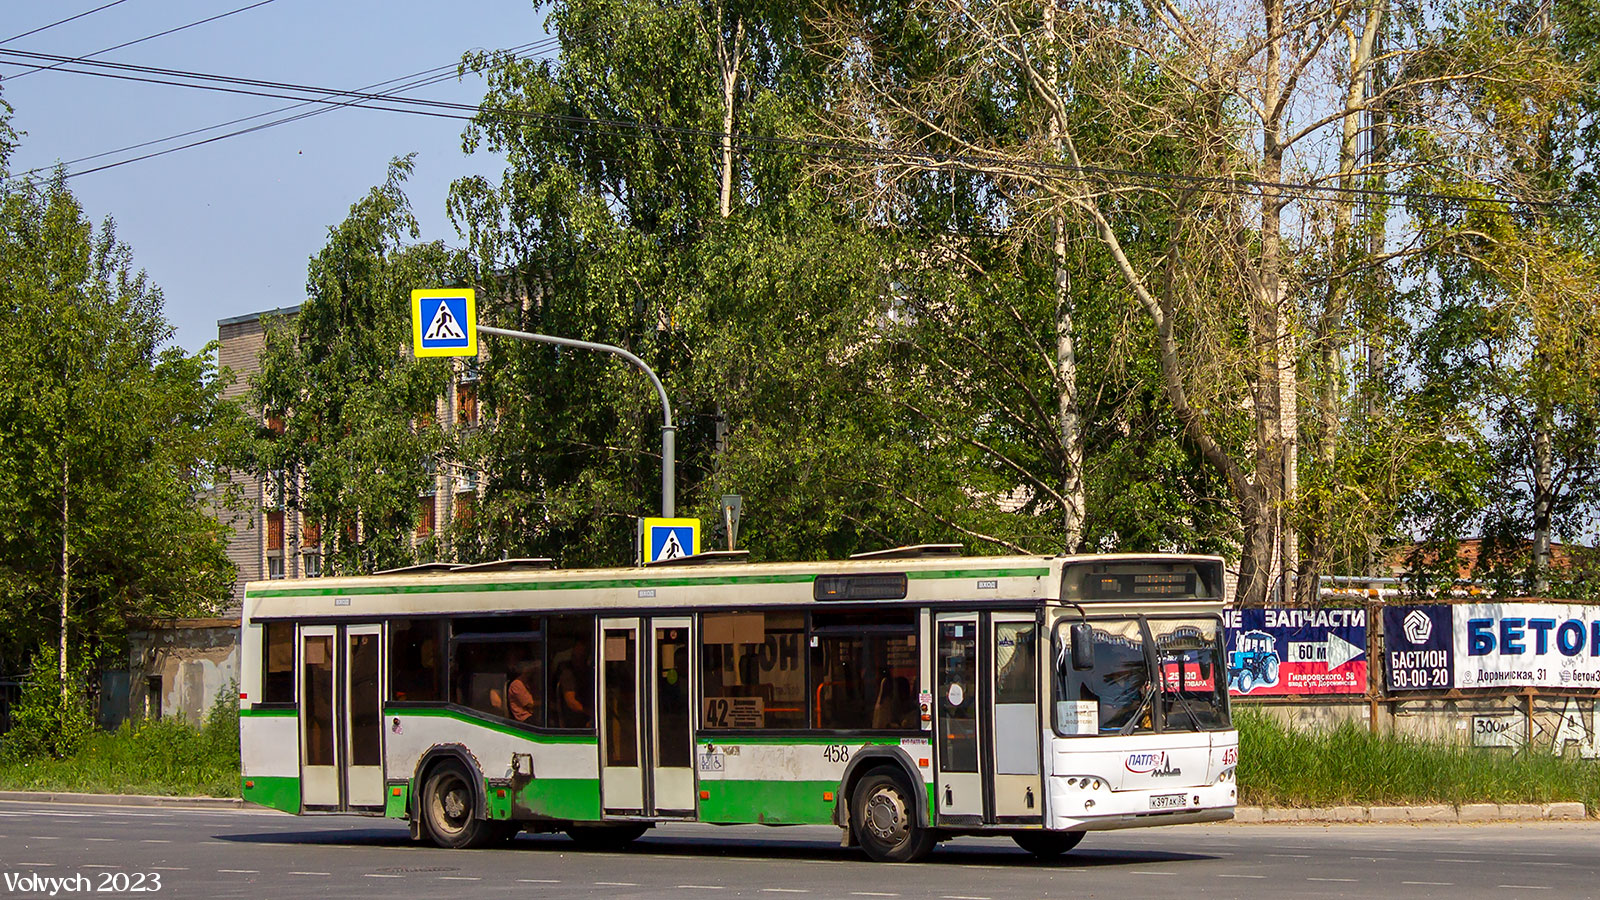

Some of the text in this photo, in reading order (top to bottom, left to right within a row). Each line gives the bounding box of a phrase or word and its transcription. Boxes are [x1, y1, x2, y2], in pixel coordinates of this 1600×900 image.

[1265, 610, 1365, 628] ЗАПЧАСТИ
[1299, 645, 1313, 660] 60
[1391, 650, 1447, 669] БАСТИОН
[1288, 672, 1344, 681] Гиляровского,
[1393, 668, 1449, 687] 50-00-20
[1537, 668, 1547, 681] 31
[706, 699, 728, 727] 42
[823, 744, 850, 763] 458
